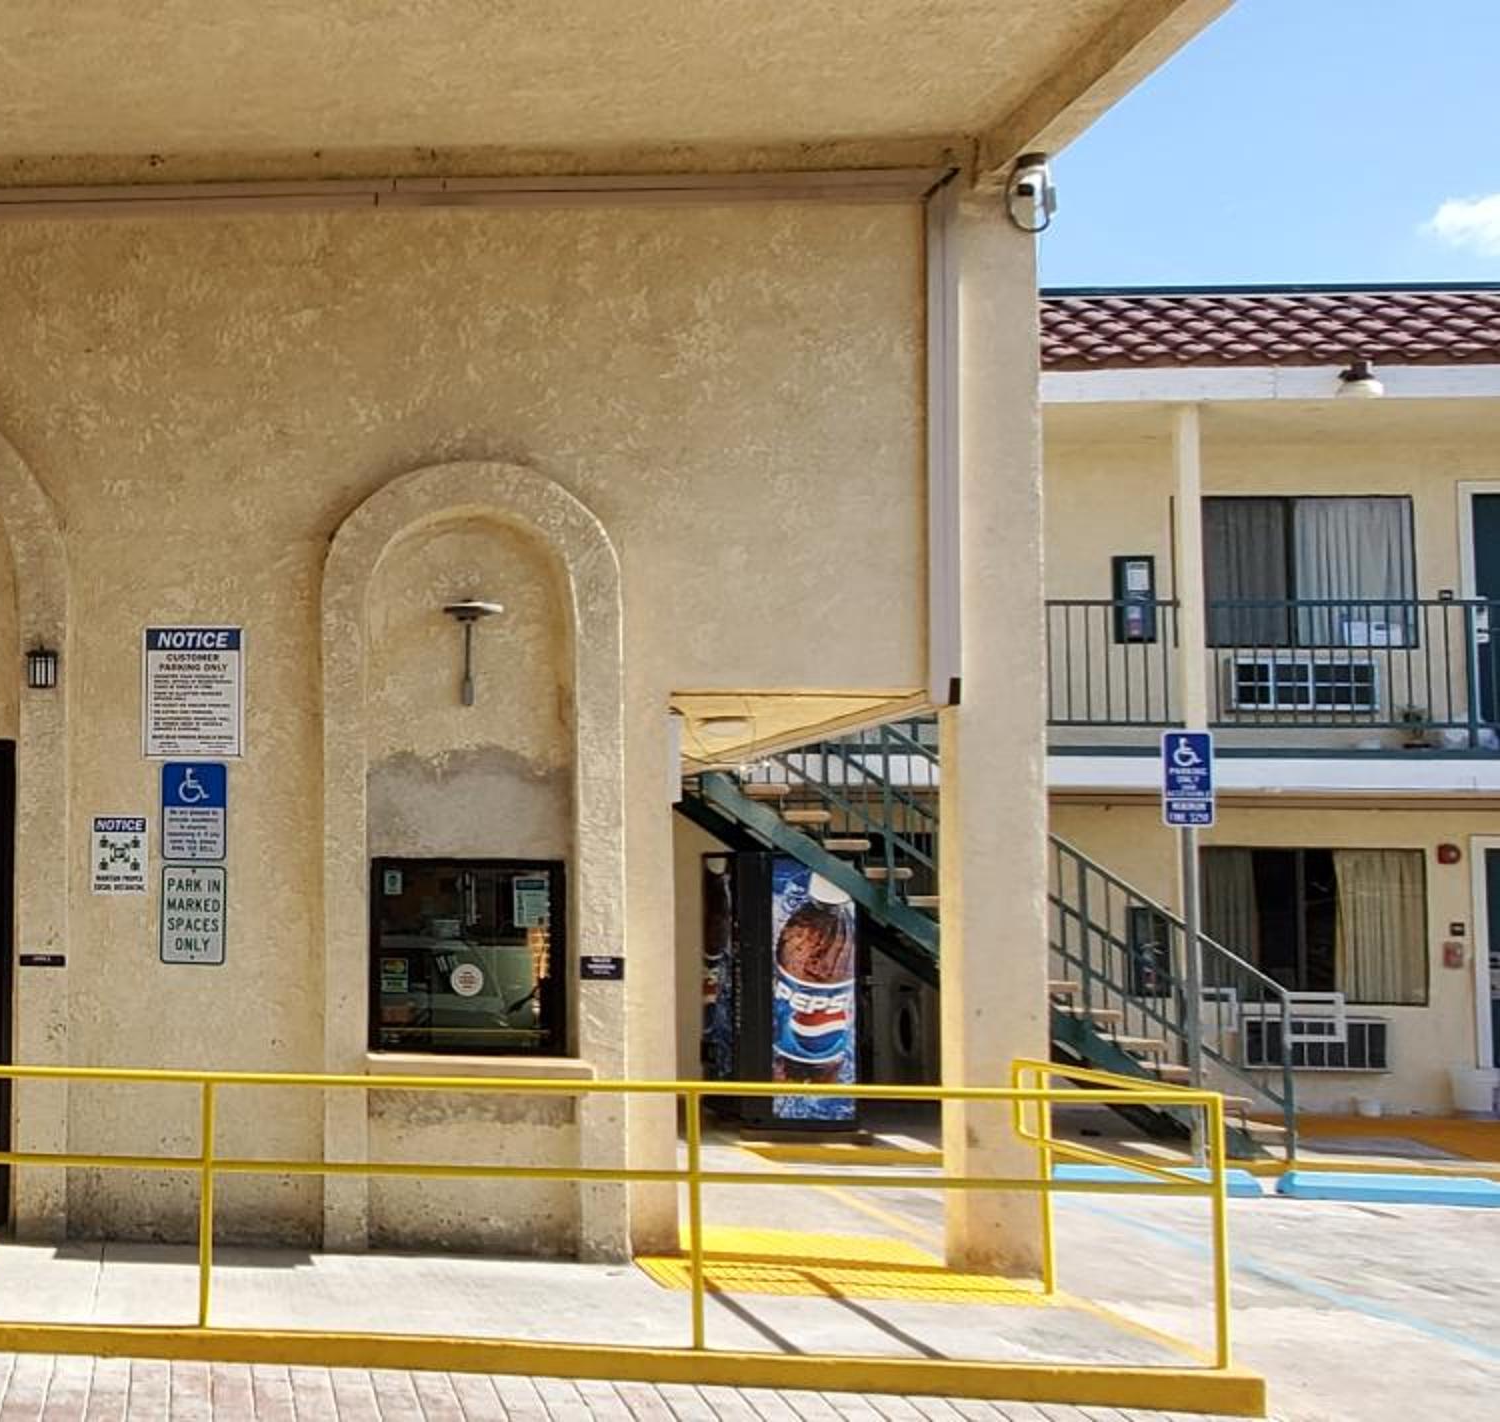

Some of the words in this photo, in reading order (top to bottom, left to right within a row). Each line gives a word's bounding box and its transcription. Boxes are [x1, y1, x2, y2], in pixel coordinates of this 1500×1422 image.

[157, 631, 229, 649] NOTICE
[166, 653, 220, 662] CUSTOMER
[160, 664, 200, 672] PARKING
[203, 663, 228, 672] ONLY
[96, 819, 143, 830] NOTICE
[167, 878, 202, 892] PARK
[207, 880, 220, 893] IN
[167, 898, 220, 912] MARKED
[167, 917, 219, 932] SPACES
[175, 938, 210, 952] ONLY
